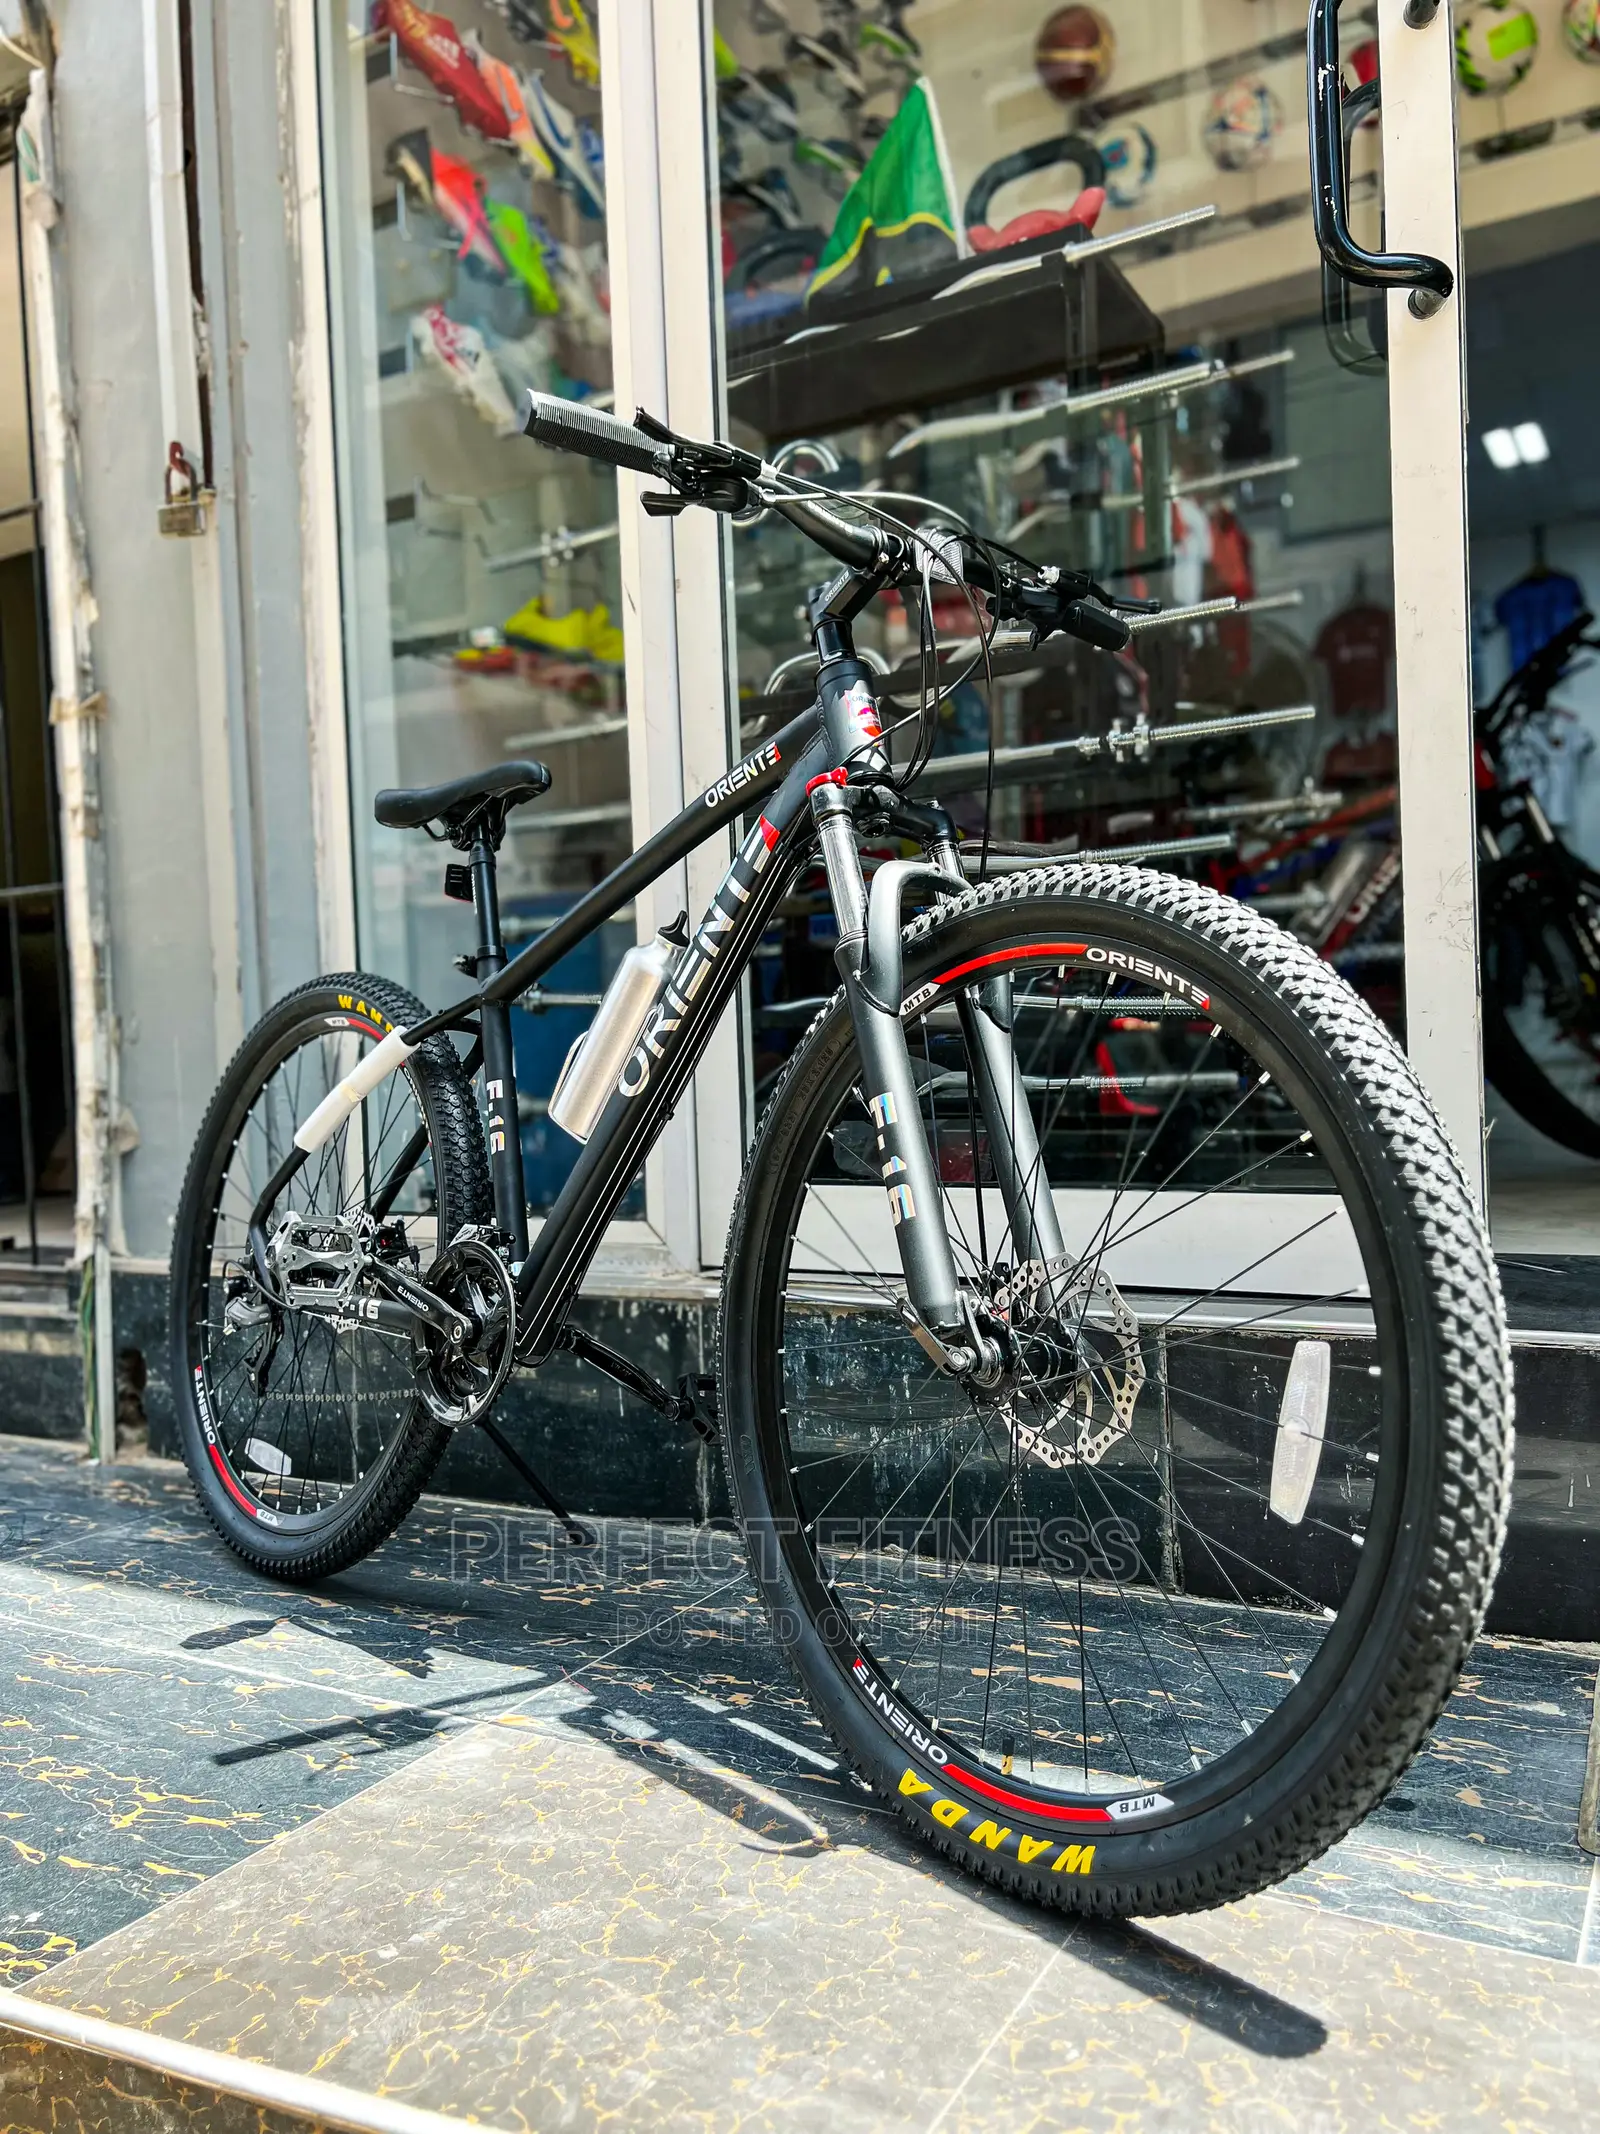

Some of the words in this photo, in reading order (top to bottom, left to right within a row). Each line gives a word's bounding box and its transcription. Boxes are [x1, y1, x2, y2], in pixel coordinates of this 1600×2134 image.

[903, 987, 933, 1013] MTB
[1118, 1795, 1157, 1815] MTB
[897, 1766, 1097, 1876] WANDA
